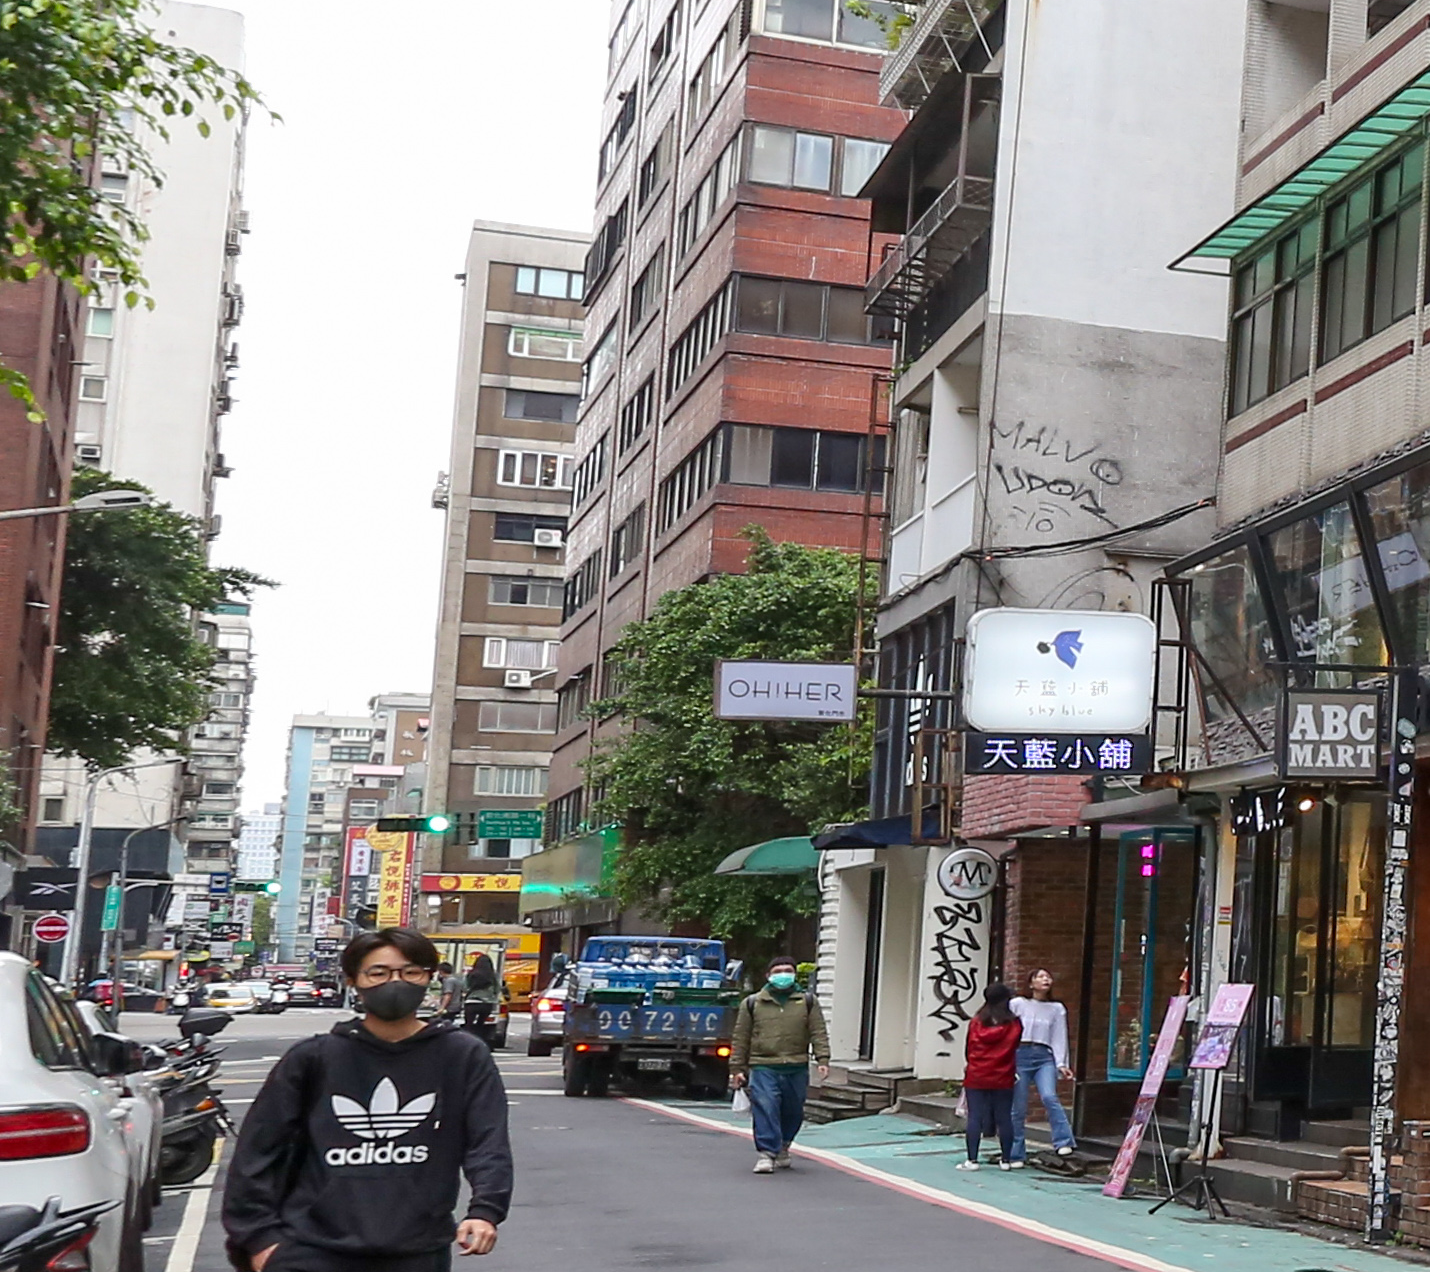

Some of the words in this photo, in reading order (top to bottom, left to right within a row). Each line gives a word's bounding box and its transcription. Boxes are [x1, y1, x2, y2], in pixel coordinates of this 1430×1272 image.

[1014, 679, 1109, 697] 天藍小舖
[1028, 705, 1055, 717] sky
[1062, 704, 1093, 716] blue
[1289, 704, 1376, 741] ABC
[983, 738, 1133, 769] 天藍小舖
[1289, 744, 1376, 768] MART
[325, 1141, 429, 1166] adidas
